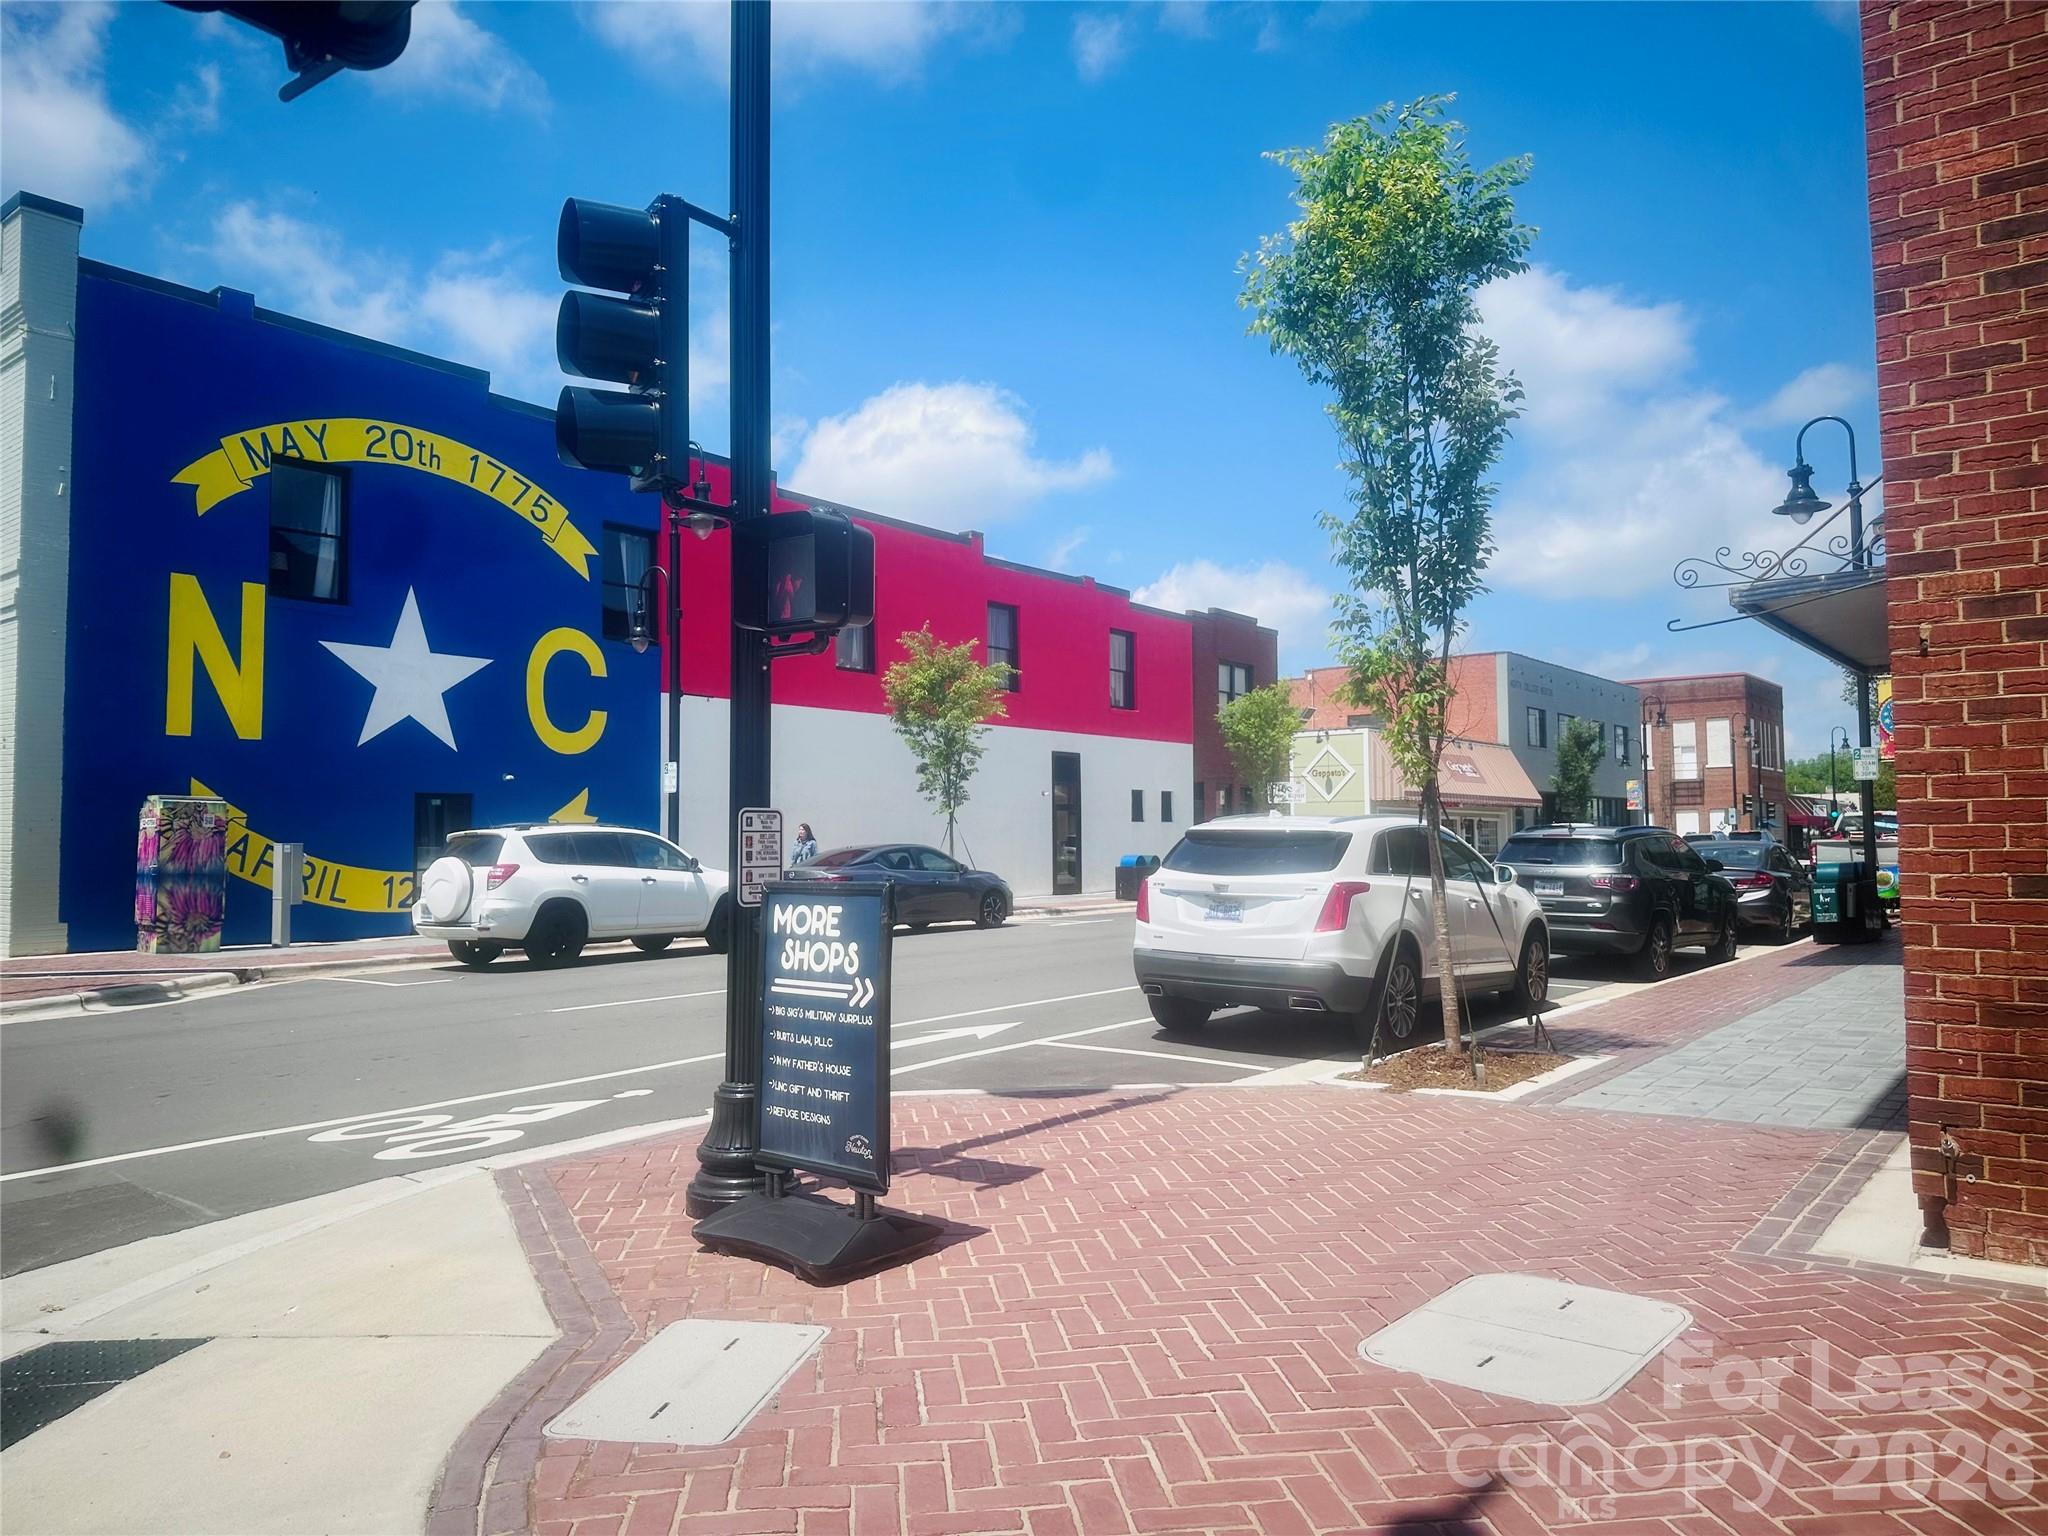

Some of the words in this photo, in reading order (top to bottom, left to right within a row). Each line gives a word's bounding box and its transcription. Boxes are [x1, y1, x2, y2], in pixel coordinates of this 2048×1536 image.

[240, 423, 328, 471] MAY
[365, 425, 441, 470] 20th
[469, 454, 553, 522] 1775
[166, 572, 265, 740] N
[526, 627, 608, 755] C
[774, 904, 843, 937] MORE
[781, 938, 859, 975] SHOPS
[775, 1005, 786, 1016] BIG
[786, 1006, 804, 1018] SIG'S
[805, 1009, 837, 1022] MILITARY
[838, 1013, 873, 1026] SURPLUS
[796, 1034, 812, 1047] LAW,
[814, 1036, 834, 1048] PLLC
[782, 1057, 792, 1067] MY
[792, 1058, 824, 1073] FATHER'S
[825, 1063, 852, 1077] HOUSE
[789, 1084, 806, 1095] GIFT
[807, 1087, 823, 1098] AND
[824, 1089, 850, 1102] THRIFT
[773, 1106, 800, 1120] REFUGE
[800, 1111, 831, 1126] DESIGNS
